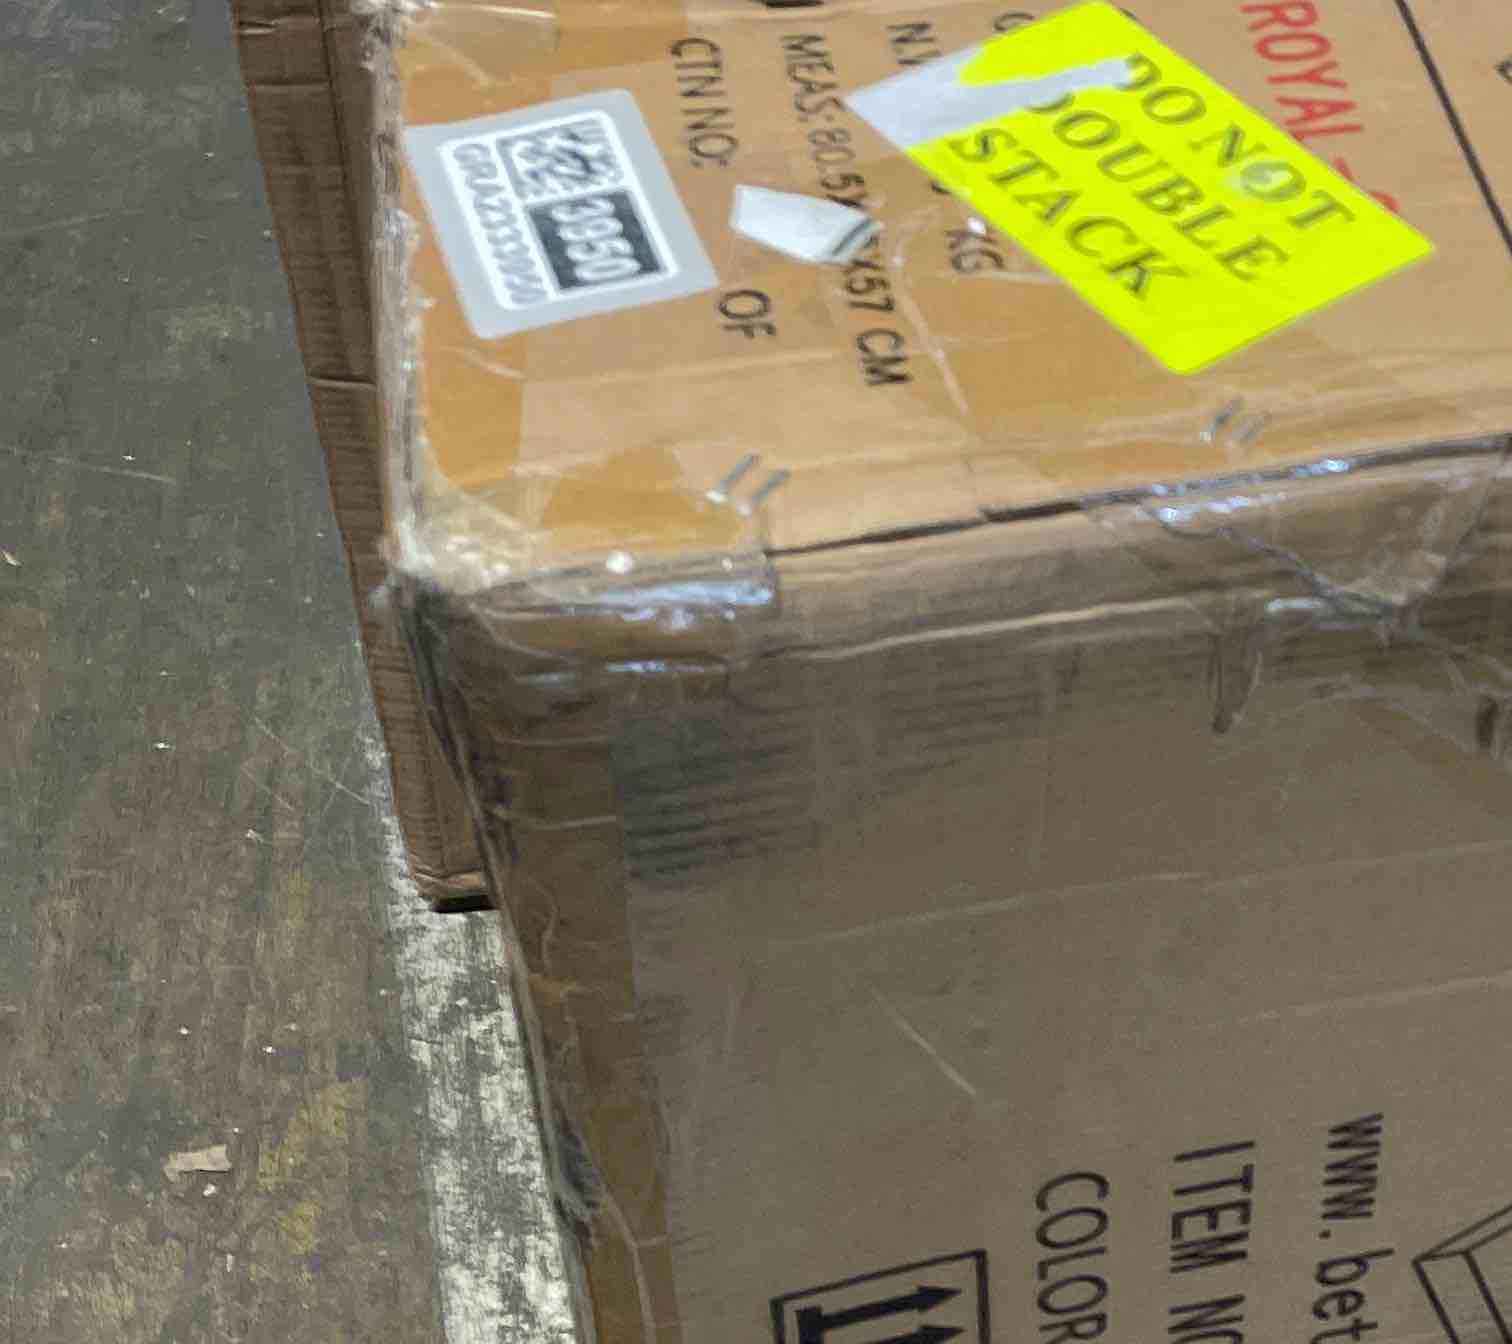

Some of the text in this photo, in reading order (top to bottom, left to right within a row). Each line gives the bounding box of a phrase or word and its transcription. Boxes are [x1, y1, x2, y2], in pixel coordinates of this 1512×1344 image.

[671, 38, 727, 97] CTN
[717, 288, 776, 340] OF
[948, 127, 1193, 300] STACK
[1188, 123, 1356, 231] NOT
[856, 328, 912, 386] CM
[1169, 1139, 1256, 1275] ITEM
